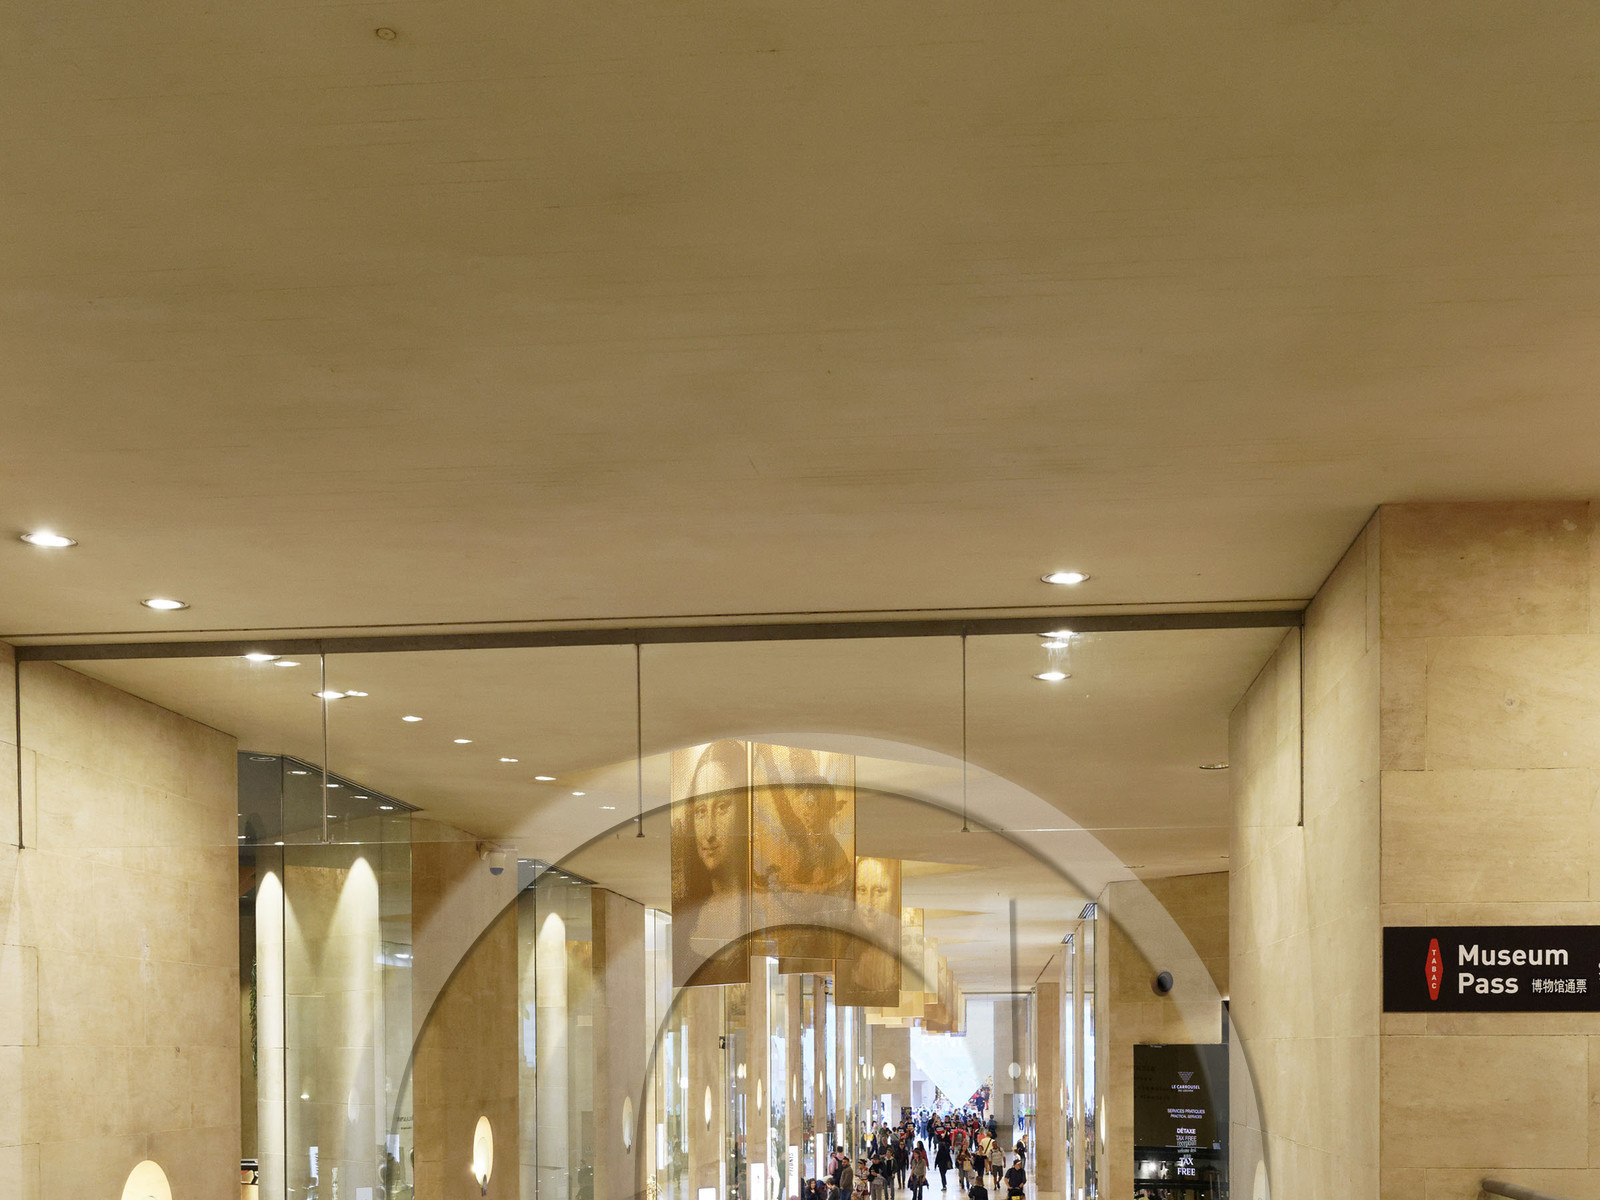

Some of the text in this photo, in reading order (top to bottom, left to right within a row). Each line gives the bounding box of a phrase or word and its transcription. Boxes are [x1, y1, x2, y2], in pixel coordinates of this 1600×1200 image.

[1458, 944, 1569, 966] Museum
[1458, 972, 1519, 994] Pass
[1531, 978, 1588, 994] 博物馆通票
[1179, 1157, 1194, 1166] TAX
[1177, 1167, 1196, 1176] FREE
